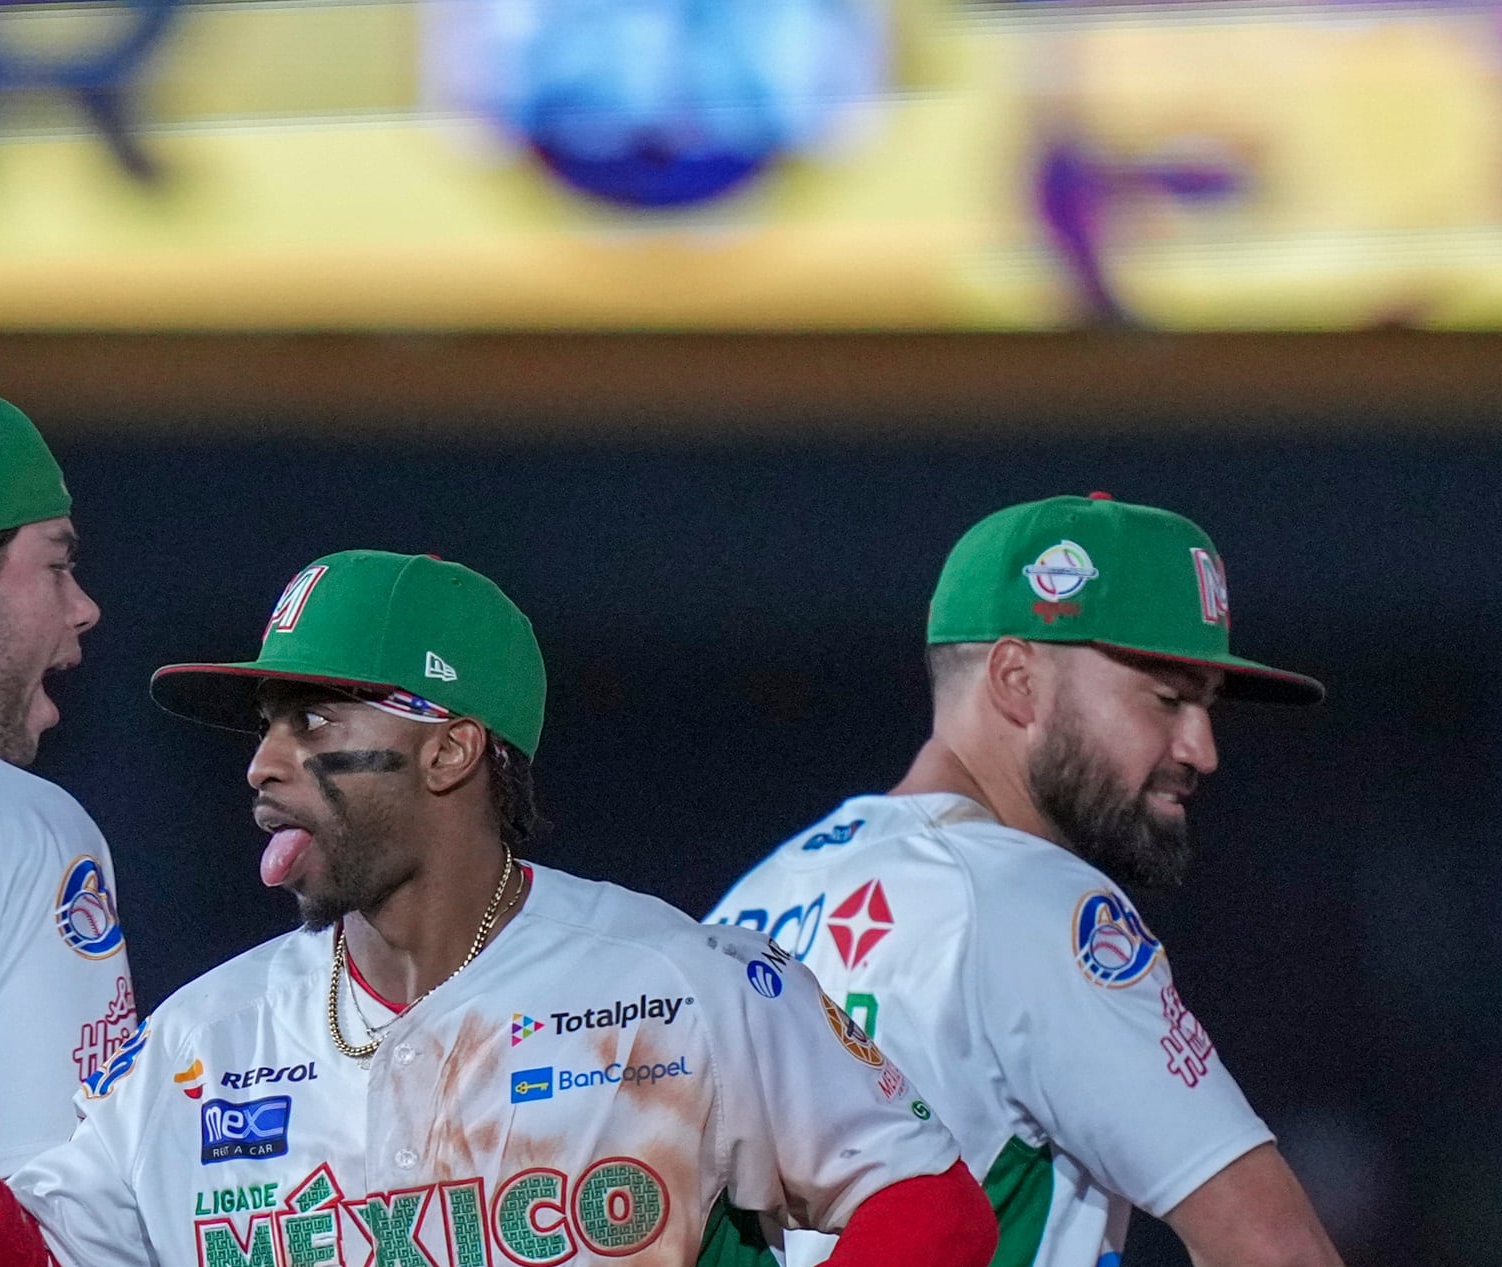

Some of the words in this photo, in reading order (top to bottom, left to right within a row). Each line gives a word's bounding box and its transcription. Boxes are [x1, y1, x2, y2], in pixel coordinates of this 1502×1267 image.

[551, 994, 683, 1035] Totalplay
[220, 1061, 319, 1090] REPSOL
[558, 1055, 692, 1091] BanCoppel
[233, 1145, 243, 1154] A
[249, 1143, 273, 1155] CAR
